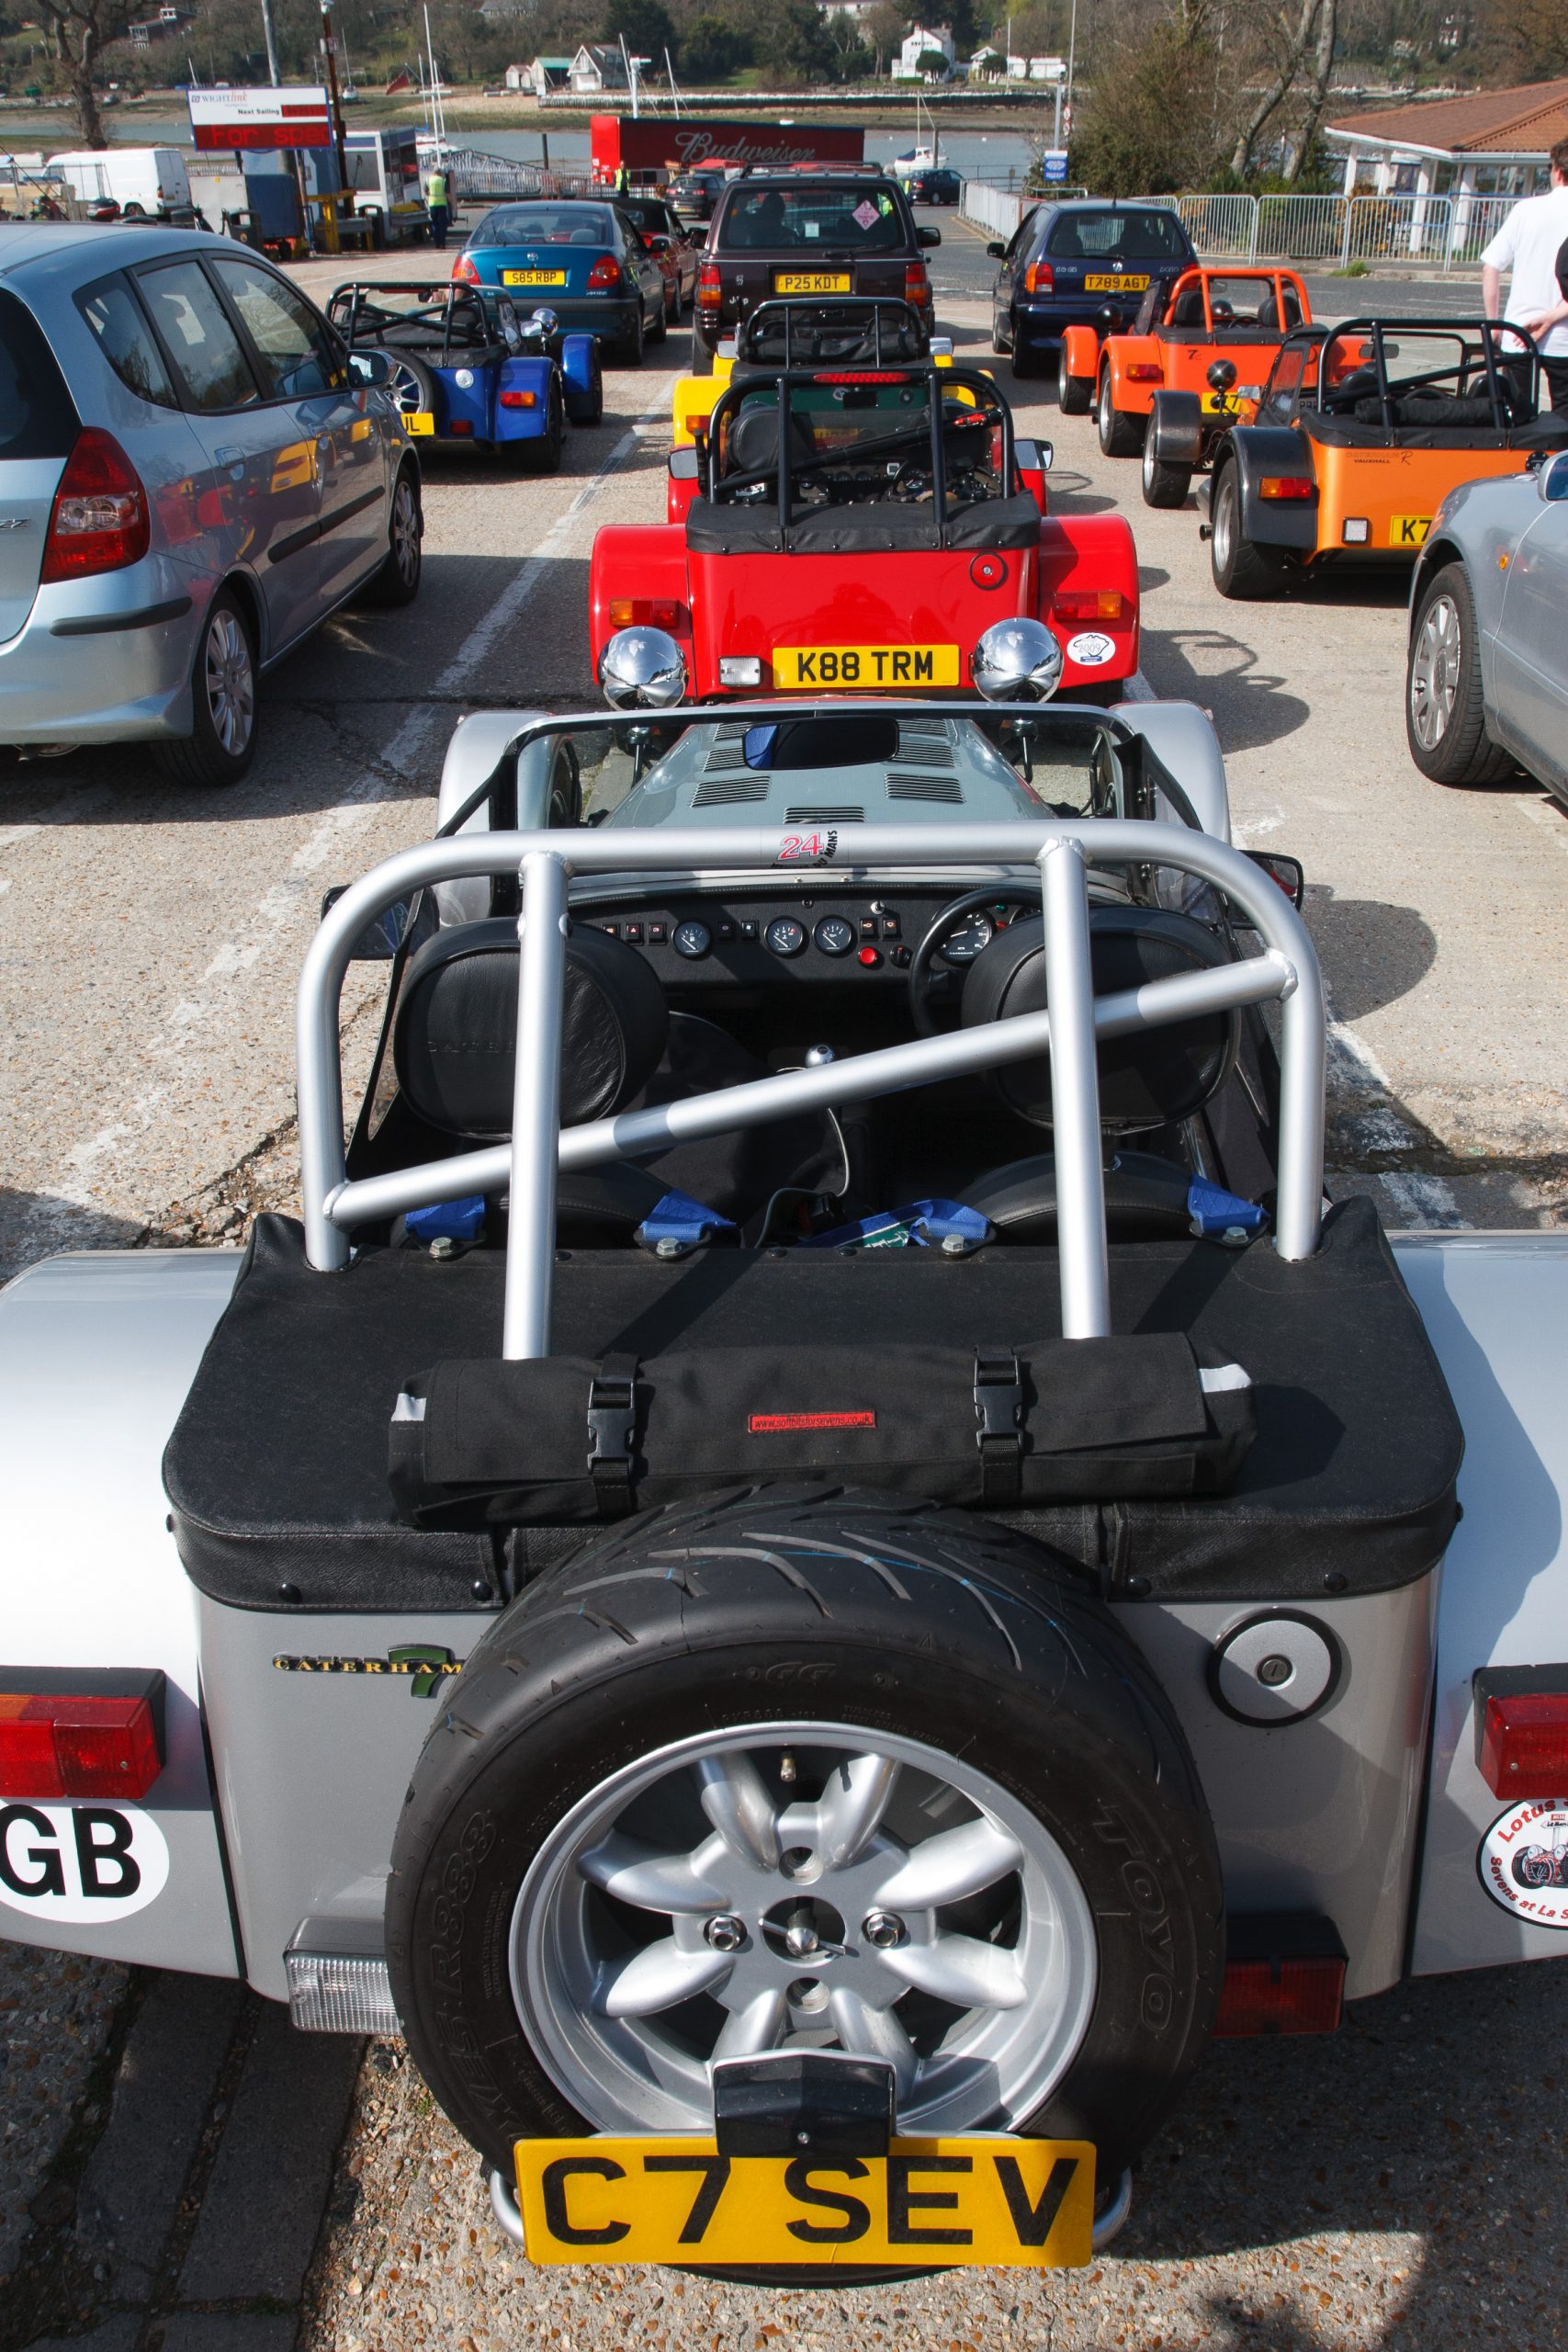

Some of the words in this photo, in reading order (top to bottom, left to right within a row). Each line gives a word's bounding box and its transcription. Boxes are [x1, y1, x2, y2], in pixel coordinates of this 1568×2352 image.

[256, 107, 280, 116] Sailing
[210, 125, 258, 147] For
[675, 131, 816, 163] Budweiser
[512, 272, 534, 283] S85
[536, 272, 557, 283] RBP
[784, 277, 811, 289] P25
[814, 277, 840, 289] KDT
[1087, 277, 1121, 288] T789
[1122, 277, 1149, 288] AGT
[797, 650, 862, 683] K88
[871, 649, 934, 682] TRM
[777, 831, 825, 861] 24
[823, 830, 838, 859] MANS
[275, 1659, 464, 1675] CATERHAM
[1497, 1799, 1556, 1843] Lotus
[0, 1804, 142, 1898] GB
[430, 1810, 498, 1990] R888
[1490, 1856, 1518, 1902] Sevens
[1518, 1899, 1537, 1912] at
[1537, 1905, 1556, 1918] La
[1091, 1804, 1176, 2032] TOYO
[541, 2154, 732, 2245] C7
[784, 2154, 1079, 2246] SEV
